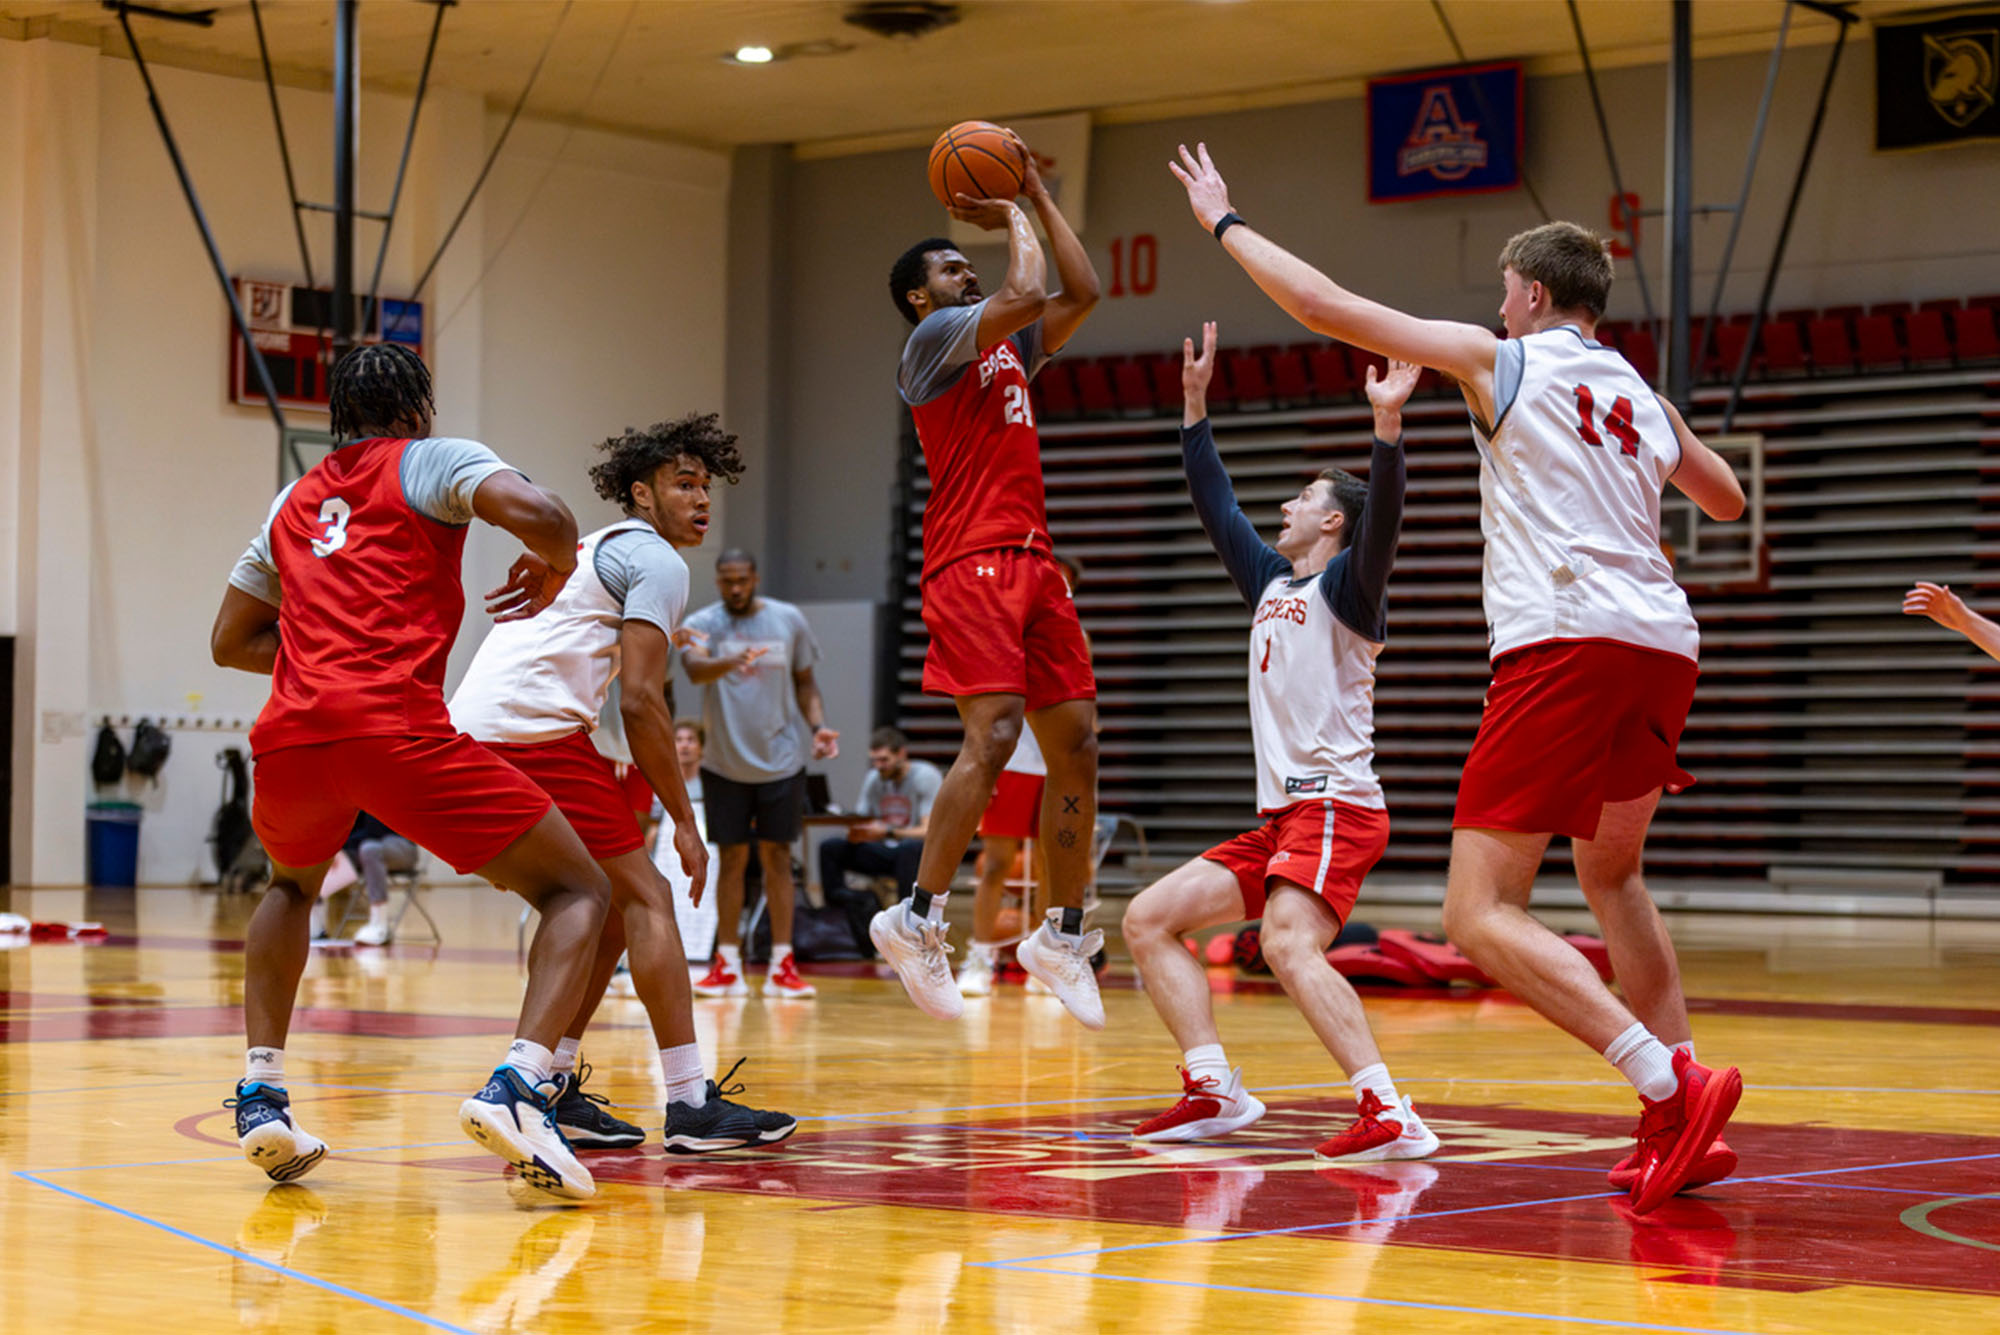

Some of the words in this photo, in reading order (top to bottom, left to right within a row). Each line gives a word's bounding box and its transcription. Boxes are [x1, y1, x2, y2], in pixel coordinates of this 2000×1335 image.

[1108, 232, 1158, 299] 10
[1572, 382, 1641, 460] 14
[309, 495, 352, 559] 3
